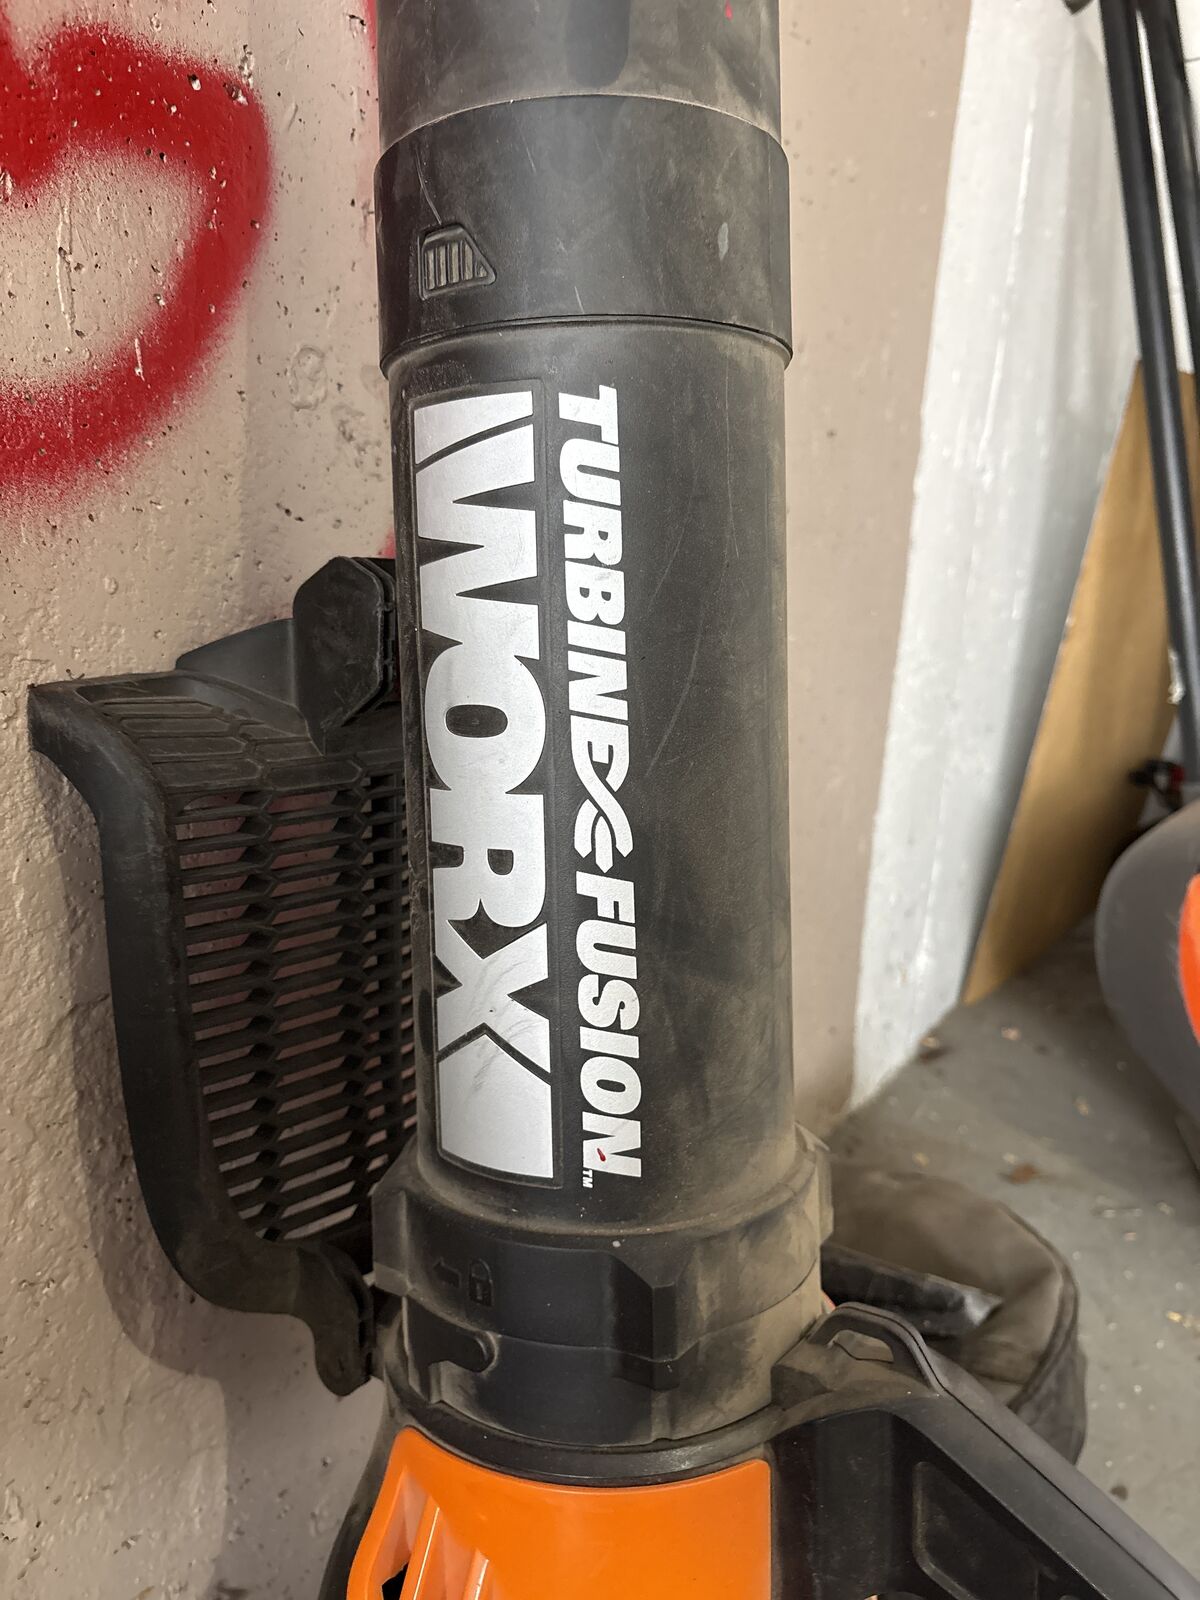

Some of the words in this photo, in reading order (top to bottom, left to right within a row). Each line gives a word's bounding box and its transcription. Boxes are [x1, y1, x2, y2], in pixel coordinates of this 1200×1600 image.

[414, 422, 550, 1074] WORX
[558, 385, 631, 794] TURBINE
[575, 871, 642, 1178] FUSION
